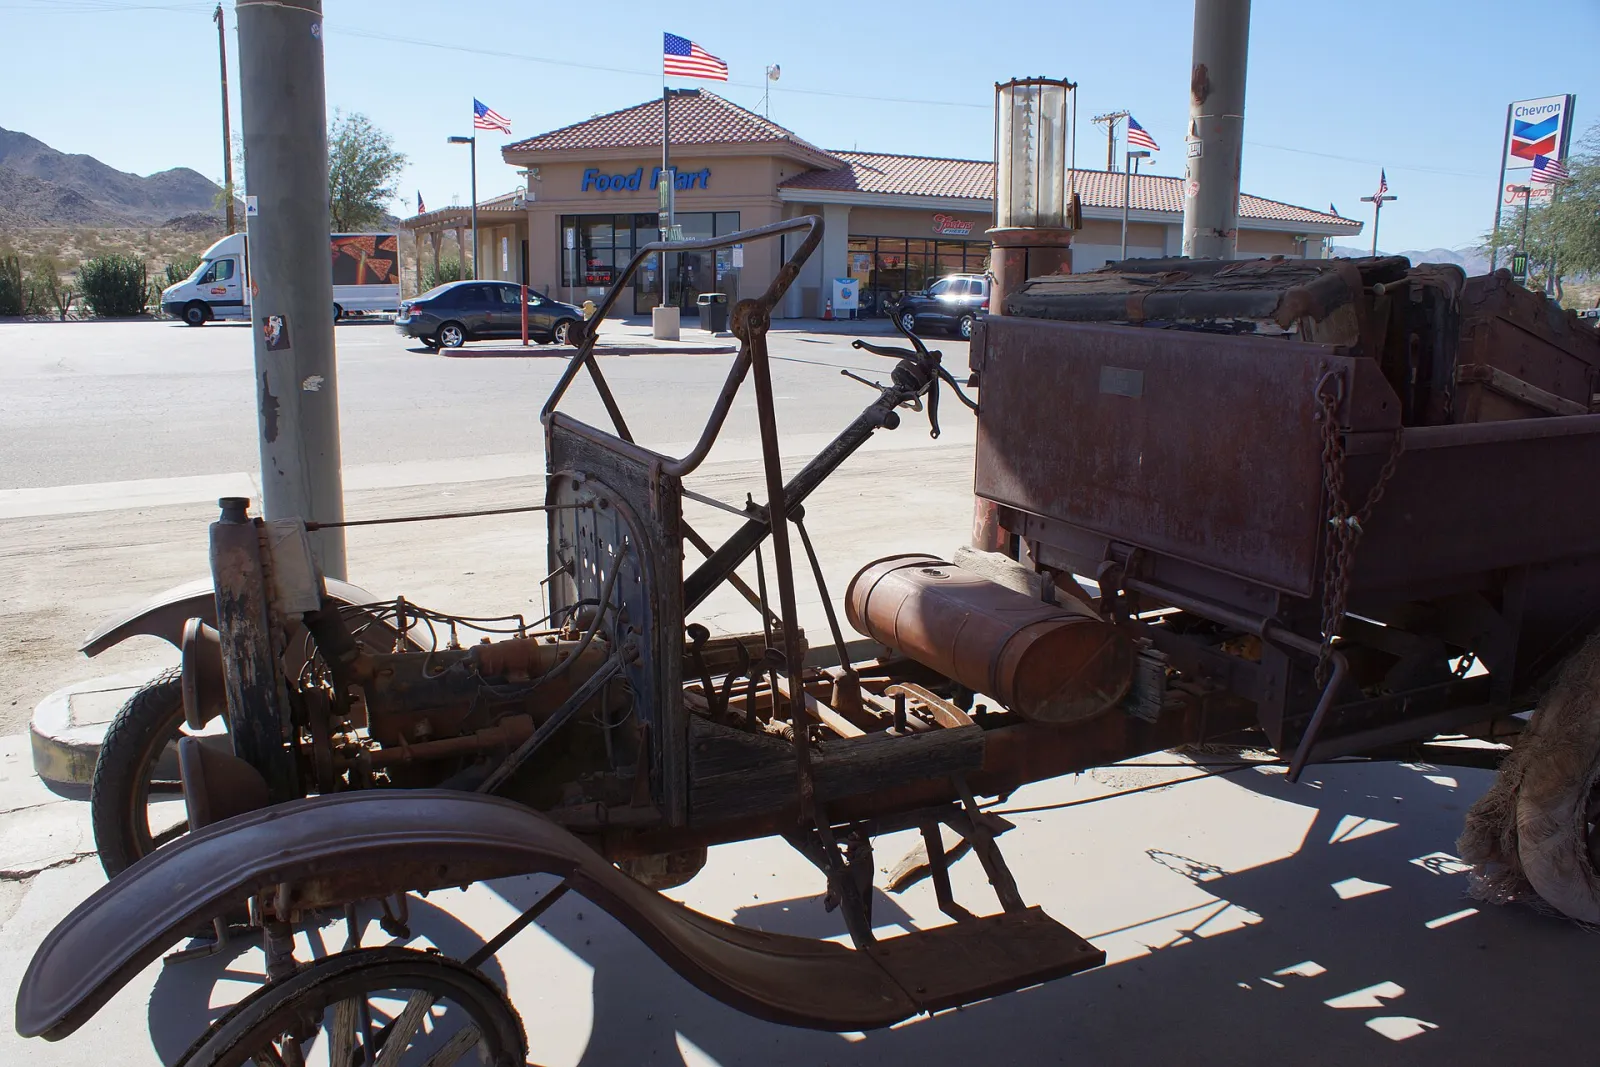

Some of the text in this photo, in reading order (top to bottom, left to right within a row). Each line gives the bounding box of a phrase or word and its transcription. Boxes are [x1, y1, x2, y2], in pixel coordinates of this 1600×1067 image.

[1515, 103, 1561, 117] Chevron
[581, 166, 644, 192] Food
[932, 213, 975, 233] Fosters
